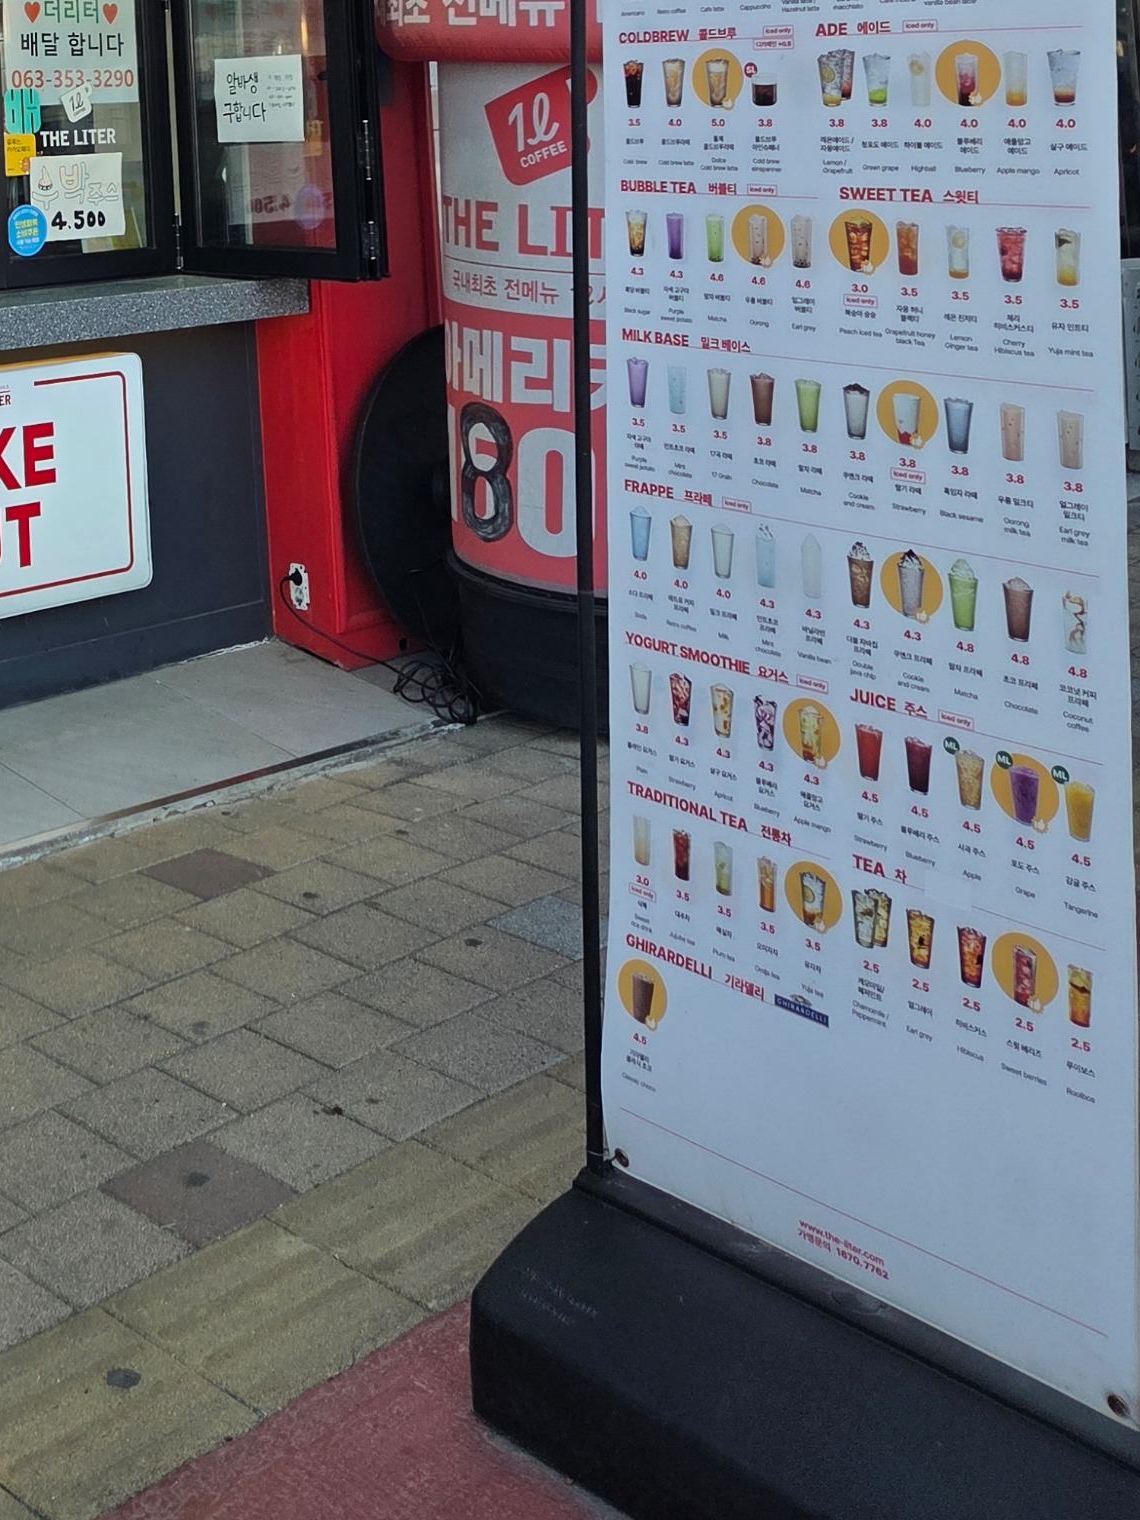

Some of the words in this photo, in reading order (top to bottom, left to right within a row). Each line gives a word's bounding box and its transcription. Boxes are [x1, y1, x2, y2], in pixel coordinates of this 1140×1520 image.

[619, 29, 690, 44] COLDBREW
[698, 27, 737, 41] 콜드브루
[815, 23, 848, 36] ADE
[857, 21, 891, 35] 에이드
[21, 32, 59, 57] 배달
[67, 32, 124, 57] 합니다
[12, 69, 134, 89] 063-353-3290
[226, 71, 258, 95] 알바생
[223, 100, 267, 123] 구합니다
[628, 118, 641, 127] 3.5
[711, 118, 725, 127] 5.0
[1056, 118, 1076, 129] 4.0
[40, 130, 69, 147] THE
[74, 128, 116, 146] LITER
[520, 141, 567, 168] COFFEE
[954, 165, 986, 175] Blueberry
[1054, 167, 1080, 176] Apricot
[620, 180, 668, 193] BUBBLE
[670, 181, 696, 194] TEA
[708, 182, 737, 196] 버블티
[839, 186, 896, 202] SWEET
[899, 188, 934, 203] TEA
[442, 195, 499, 252] THE
[452, 269, 498, 297] 국내최초
[504, 278, 559, 305] 전메뉴
[1060, 299, 1080, 309] 3.5
[622, 328, 652, 343] MILK
[654, 332, 689, 347] BASE
[700, 336, 720, 349] 밀크
[721, 339, 751, 353] 베이스
[624, 479, 674, 499] FRAPPE
[684, 489, 713, 507] 프라페
[1063, 481, 1084, 493] 3.8
[624, 631, 679, 656] YOGURT
[679, 646, 751, 674] SMOOTHIE
[758, 665, 789, 684] 요거스
[1068, 666, 1088, 679] 4.8
[850, 688, 897, 712] JUICE
[904, 701, 928, 720] 주스
[997, 753, 1012, 766] ML
[627, 781, 717, 821] TRADITIONAL
[719, 811, 748, 832] TEA
[760, 823, 792, 846] 전통차
[852, 854, 885, 878] TEA
[895, 866, 907, 885] 차
[1071, 854, 1091, 867] 4.5
[636, 874, 650, 886] 3.0
[1064, 901, 1099, 919] Tangerine
[626, 934, 713, 979] GHIRARDELLI
[776, 997, 828, 1025] GHIRARDELLI
[1070, 1037, 1091, 1052] 2.5
[799, 1219, 885, 1267] www.the-liter.com
[798, 1228, 831, 1253] 가맹문의
[836, 1247, 890, 1280] 1670.7762
